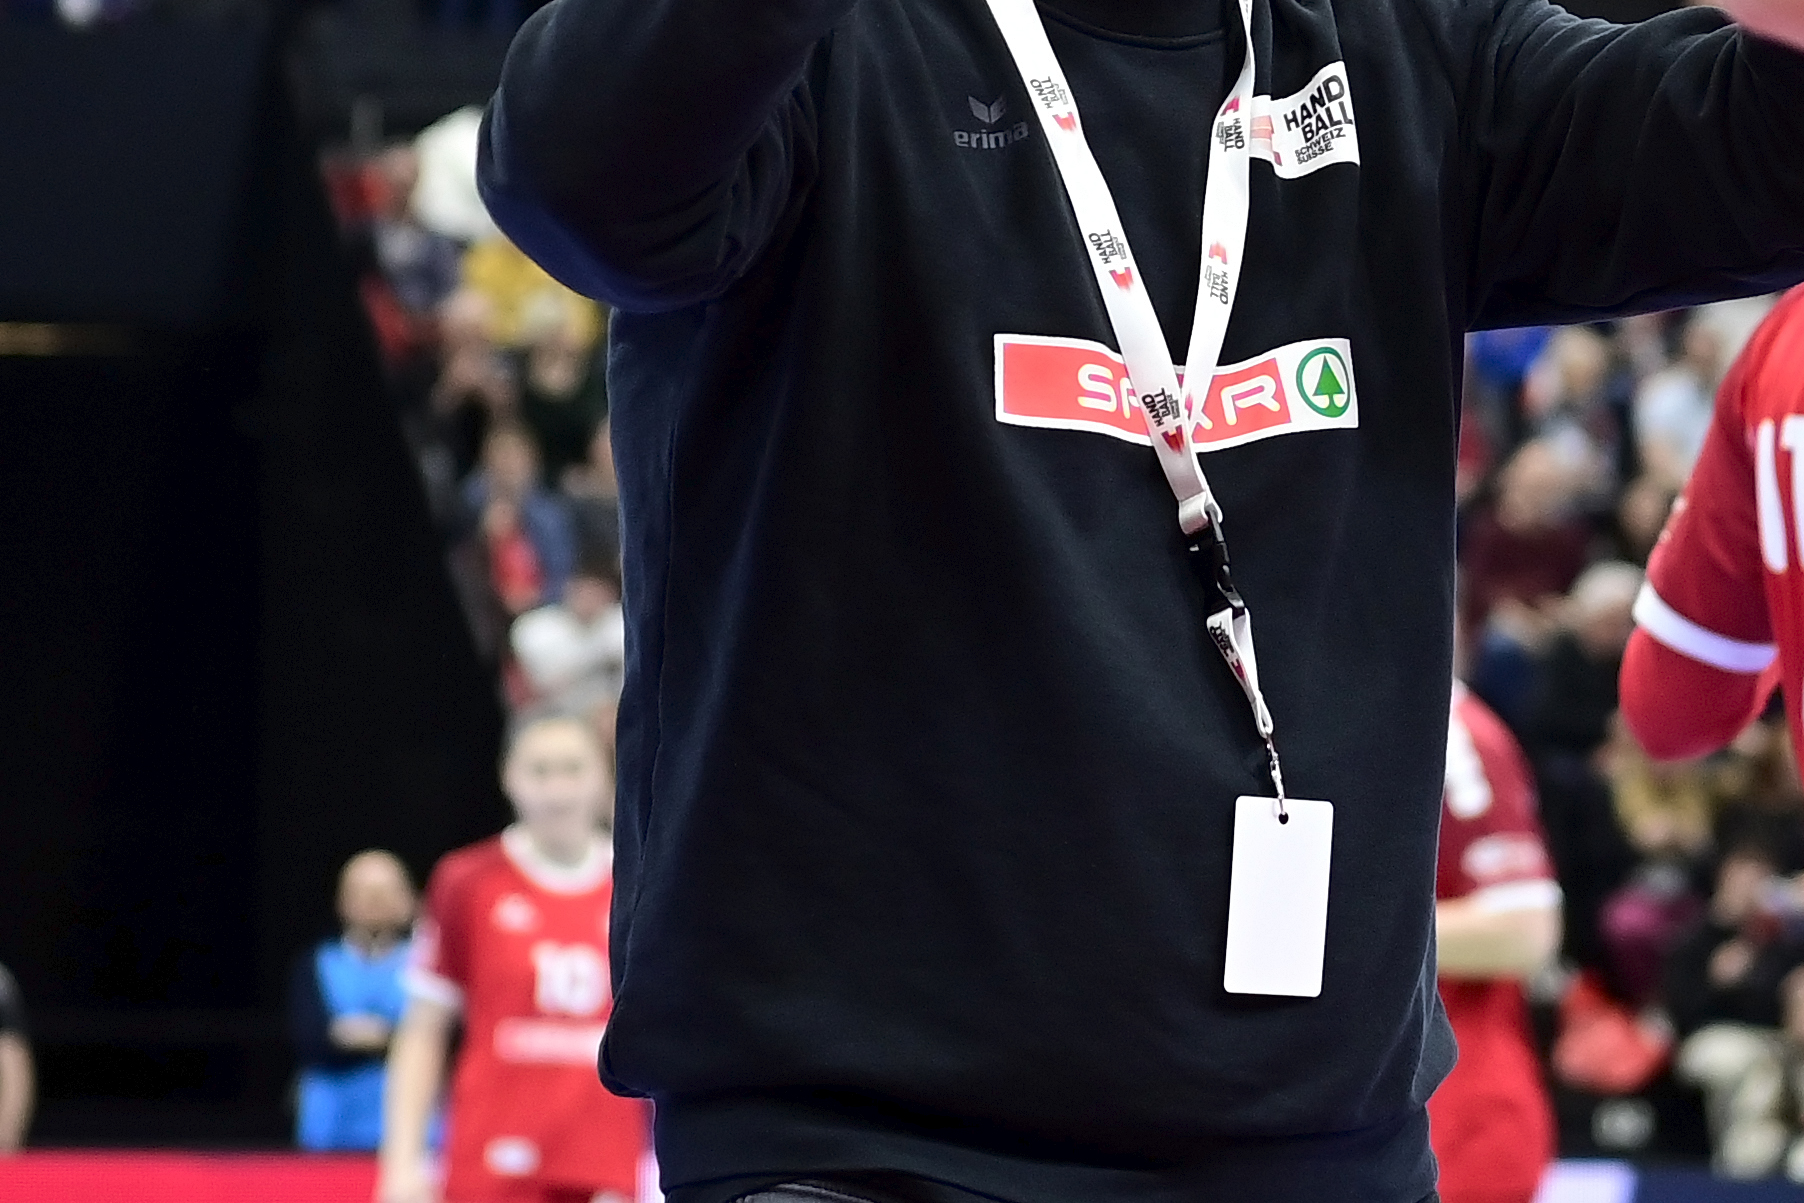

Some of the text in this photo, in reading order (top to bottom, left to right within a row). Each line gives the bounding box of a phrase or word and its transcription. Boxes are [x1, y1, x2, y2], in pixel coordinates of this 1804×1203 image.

[1283, 75, 1345, 132] HAND
[1301, 101, 1353, 144] BALL
[953, 122, 1029, 149] erima
[1297, 141, 1334, 165] SUISSE
[1077, 363, 1281, 430] SPR
